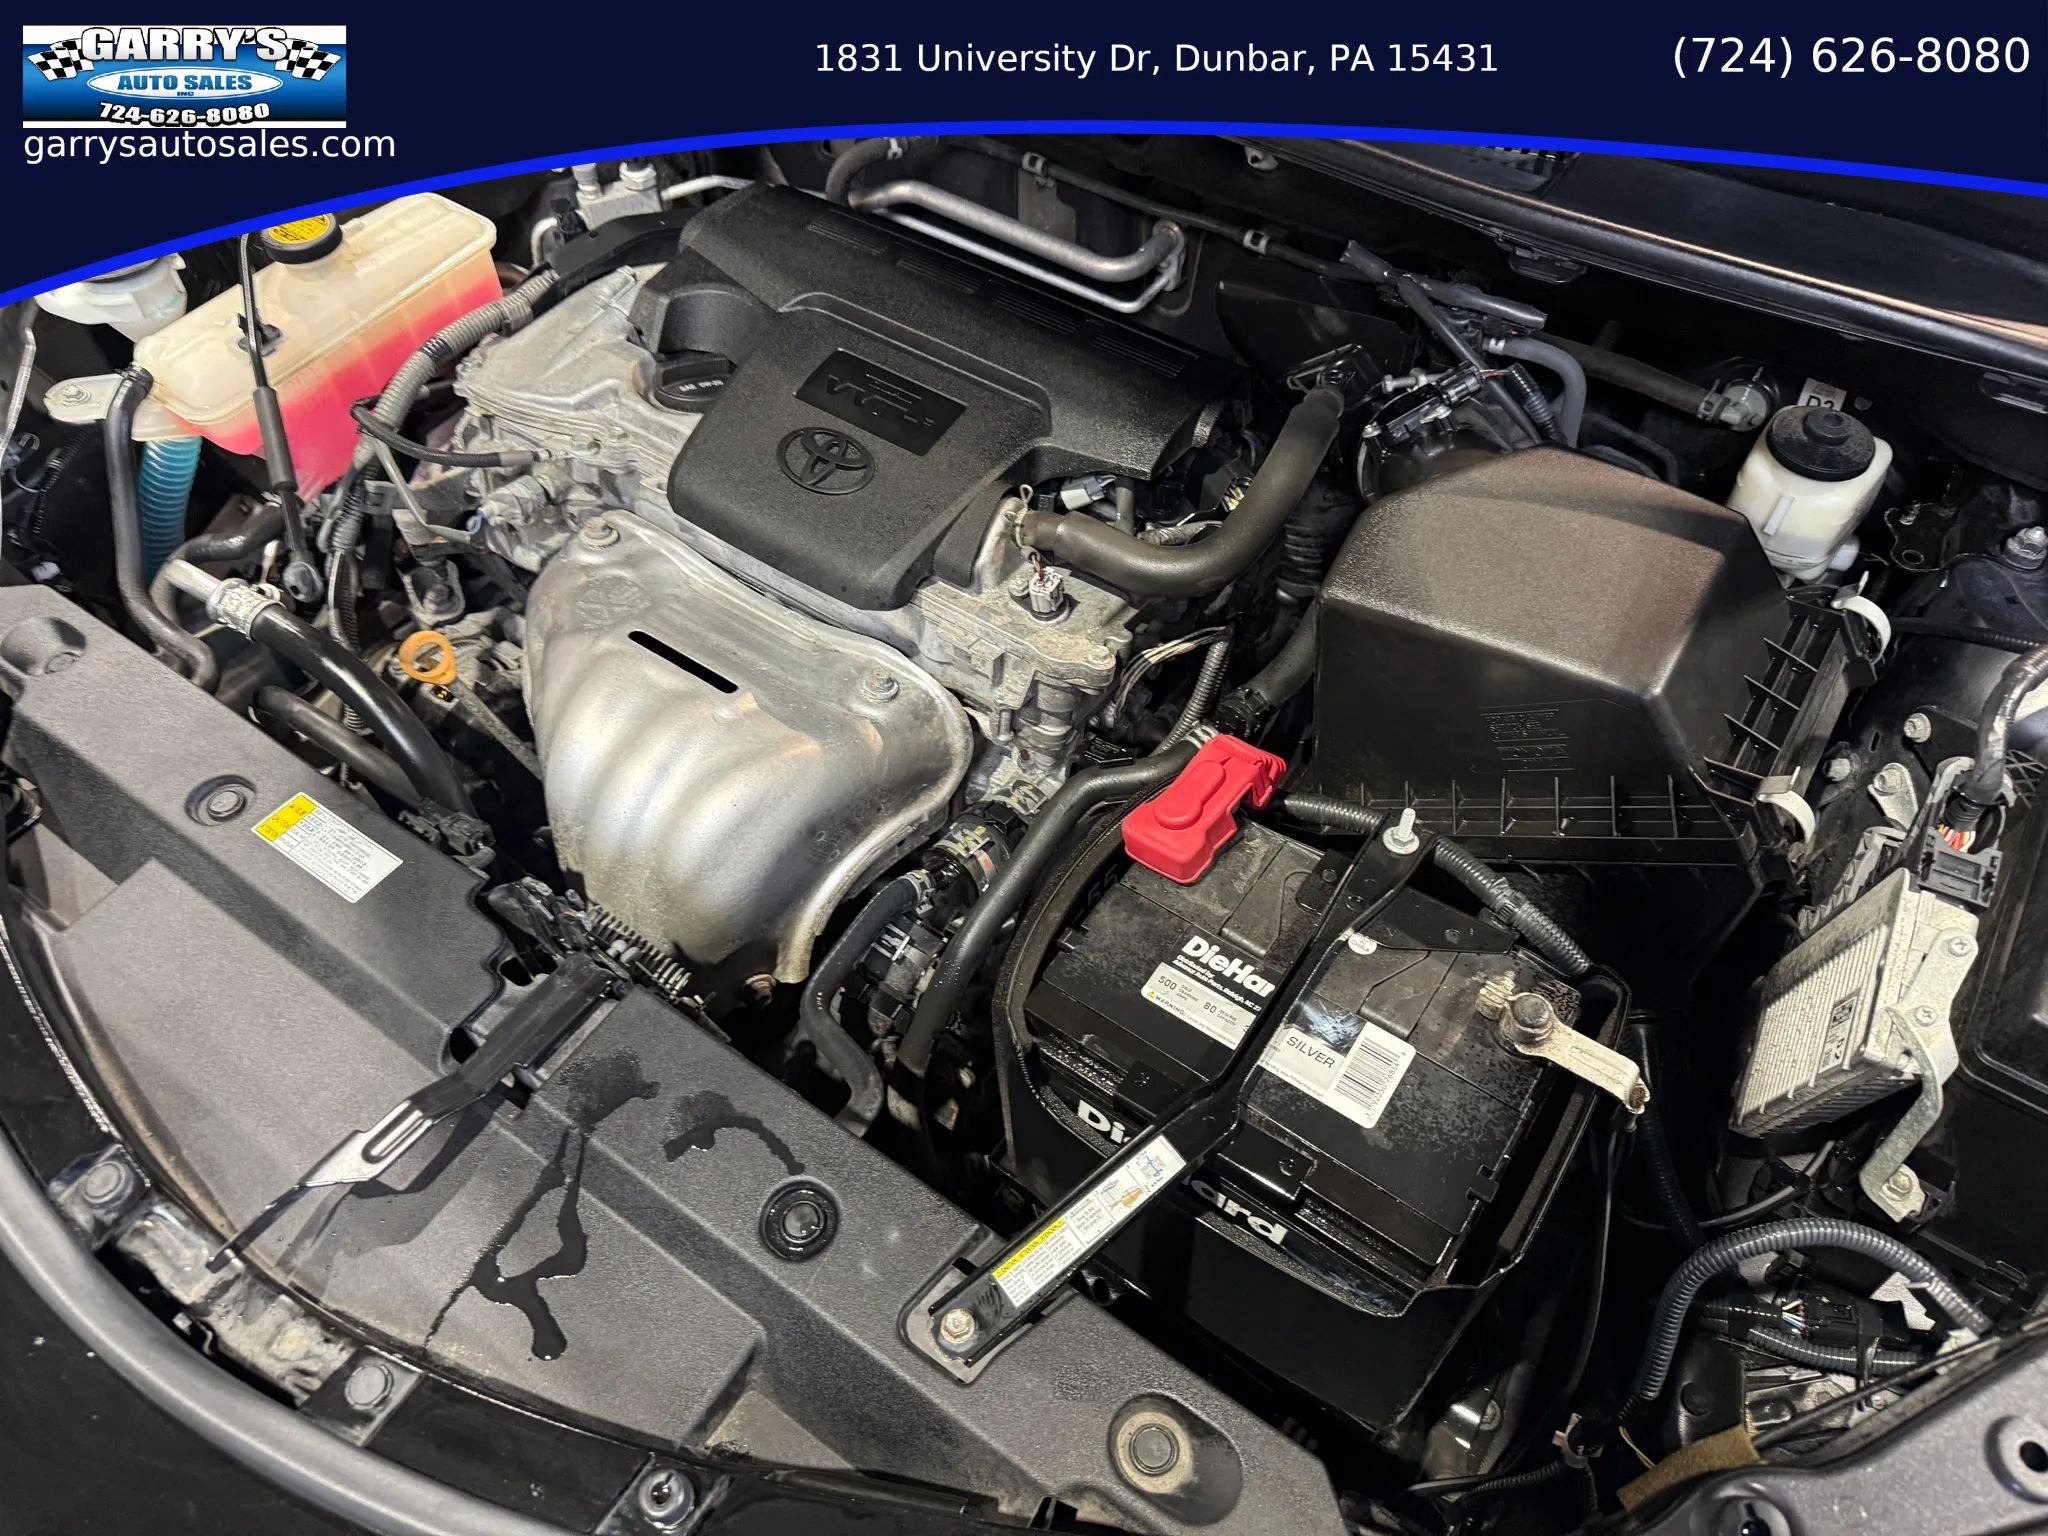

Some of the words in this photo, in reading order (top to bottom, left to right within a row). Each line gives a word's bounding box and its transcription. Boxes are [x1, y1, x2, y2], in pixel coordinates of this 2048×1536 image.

[1181, 935, 1276, 998] DieHar
[1158, 976, 1177, 991] 500
[1286, 1036, 1336, 1069] SILVER
